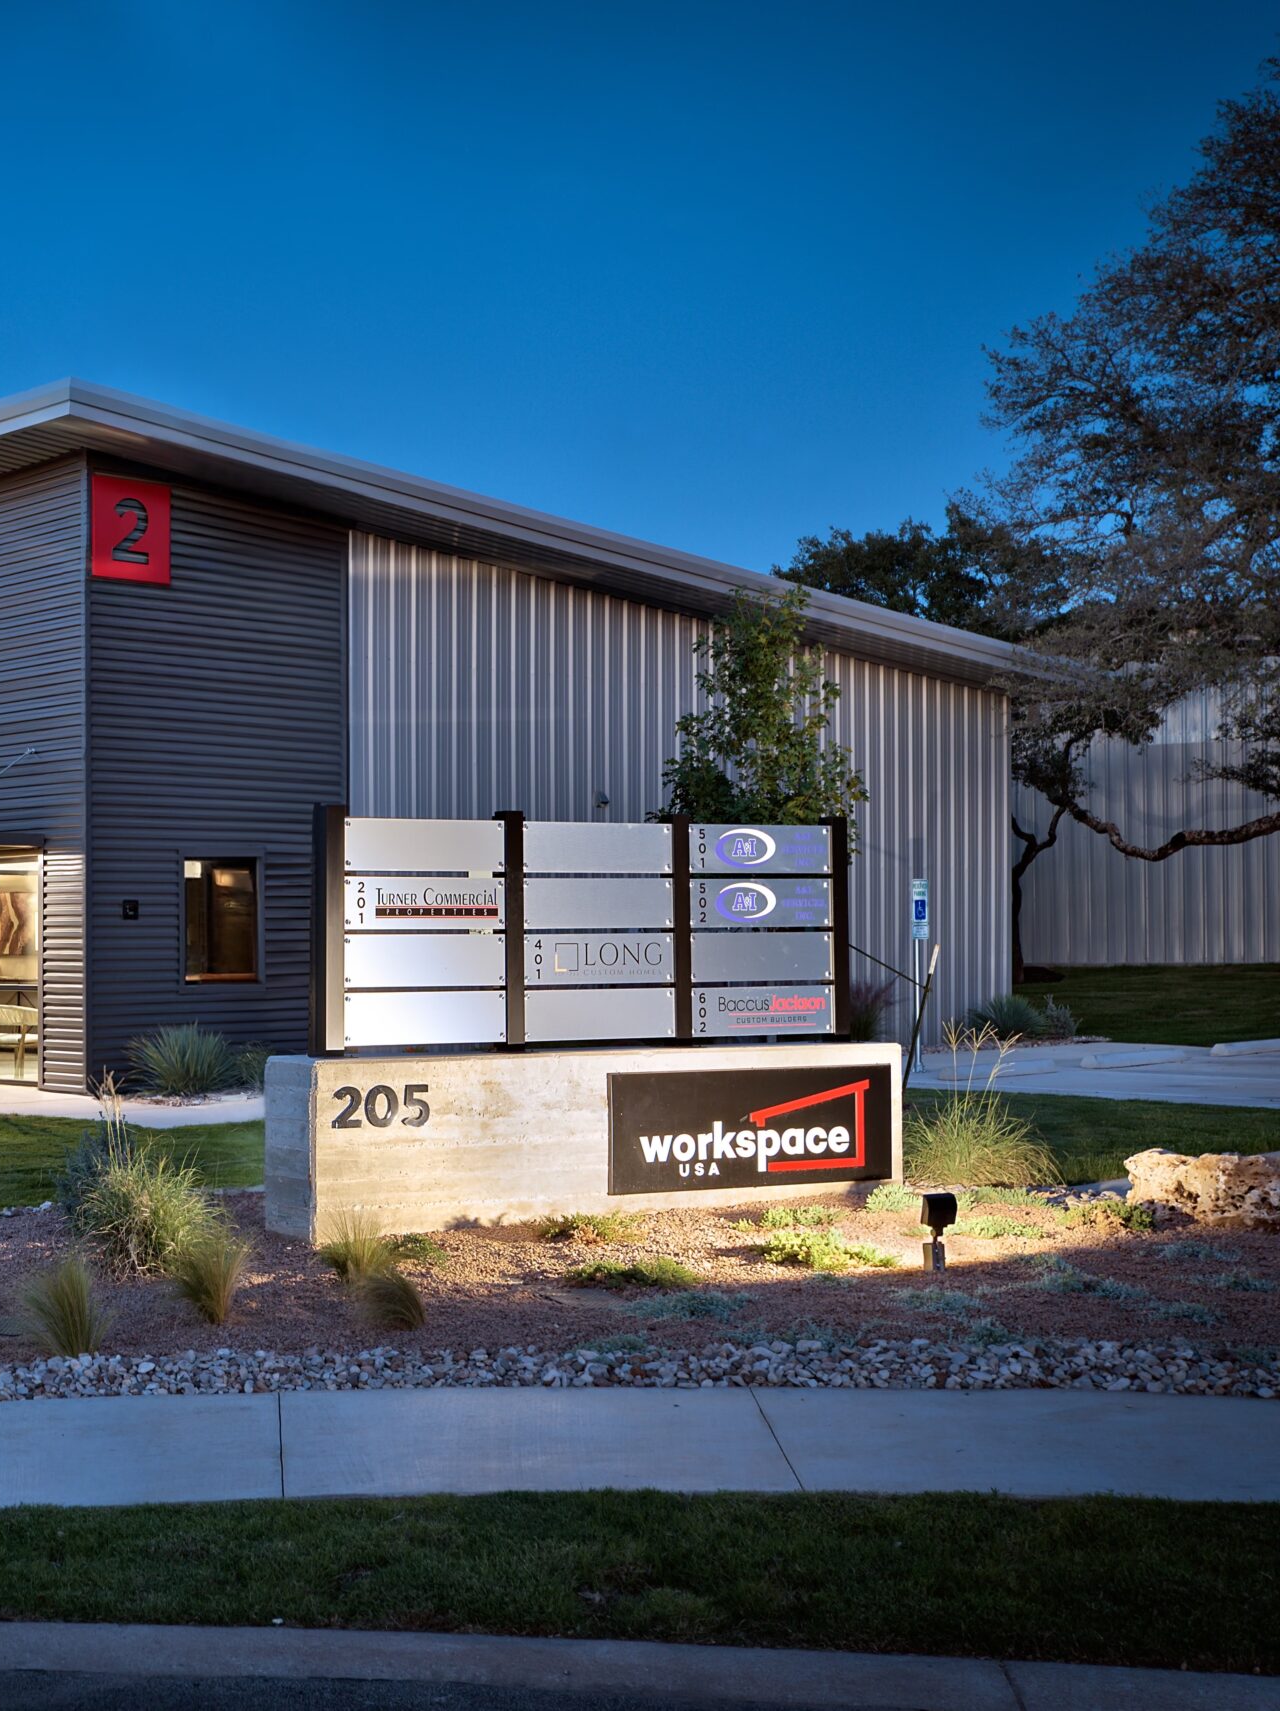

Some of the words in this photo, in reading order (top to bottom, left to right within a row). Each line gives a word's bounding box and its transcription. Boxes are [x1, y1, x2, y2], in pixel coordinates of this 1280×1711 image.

[111, 497, 149, 565] 2
[375, 887, 418, 906] TURNER
[386, 908, 488, 916] PROPERTIES
[583, 942, 663, 966] LONG
[736, 1016, 768, 1024] CUSTOM
[770, 1015, 808, 1023] BUILDERS
[331, 1084, 431, 1129] 205
[639, 1121, 850, 1172] workspace
[678, 1162, 721, 1178] USA
